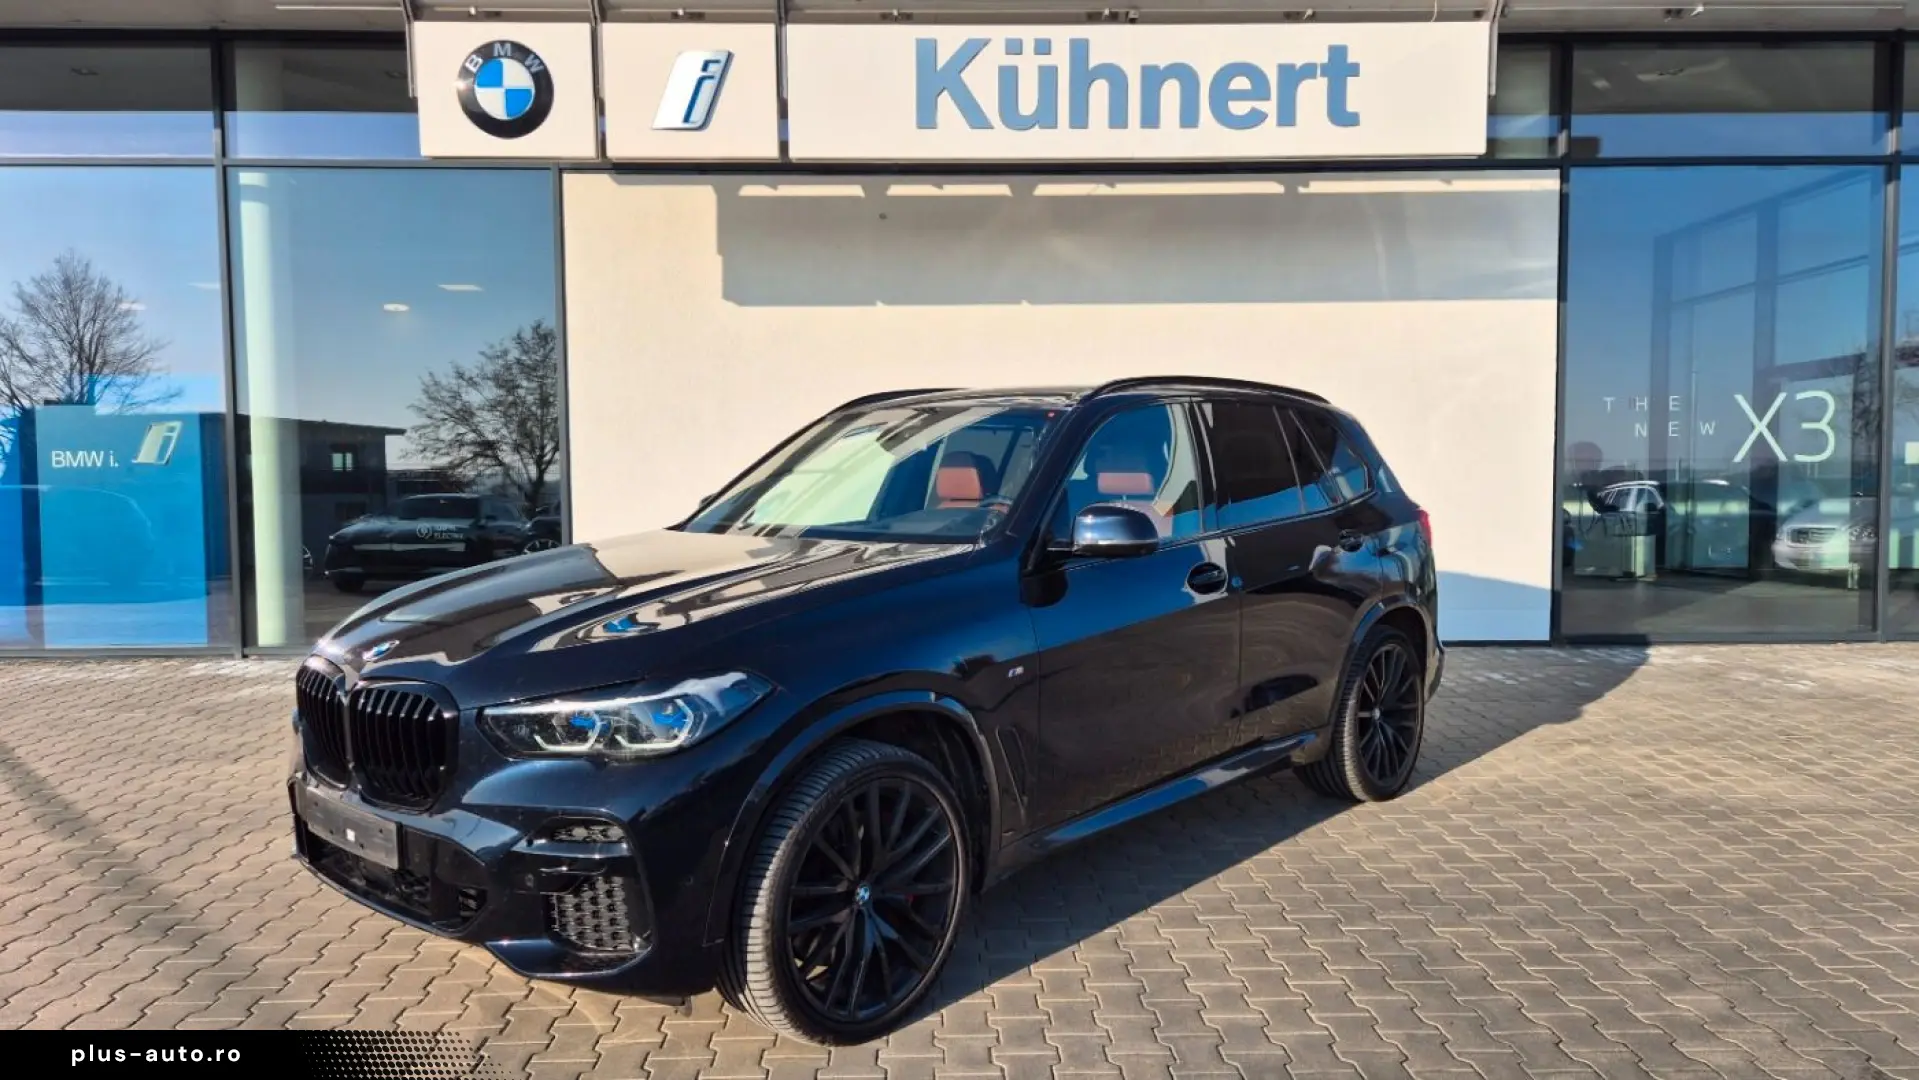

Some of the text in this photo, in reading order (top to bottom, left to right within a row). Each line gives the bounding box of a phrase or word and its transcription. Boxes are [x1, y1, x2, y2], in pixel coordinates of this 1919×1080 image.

[464, 42, 544, 74] BMW
[915, 37, 1361, 131] Kühnert
[1603, 395, 1682, 413] THE
[1634, 420, 1717, 438] NEW
[1732, 389, 1836, 463] X3
[51, 450, 104, 468] BMW
